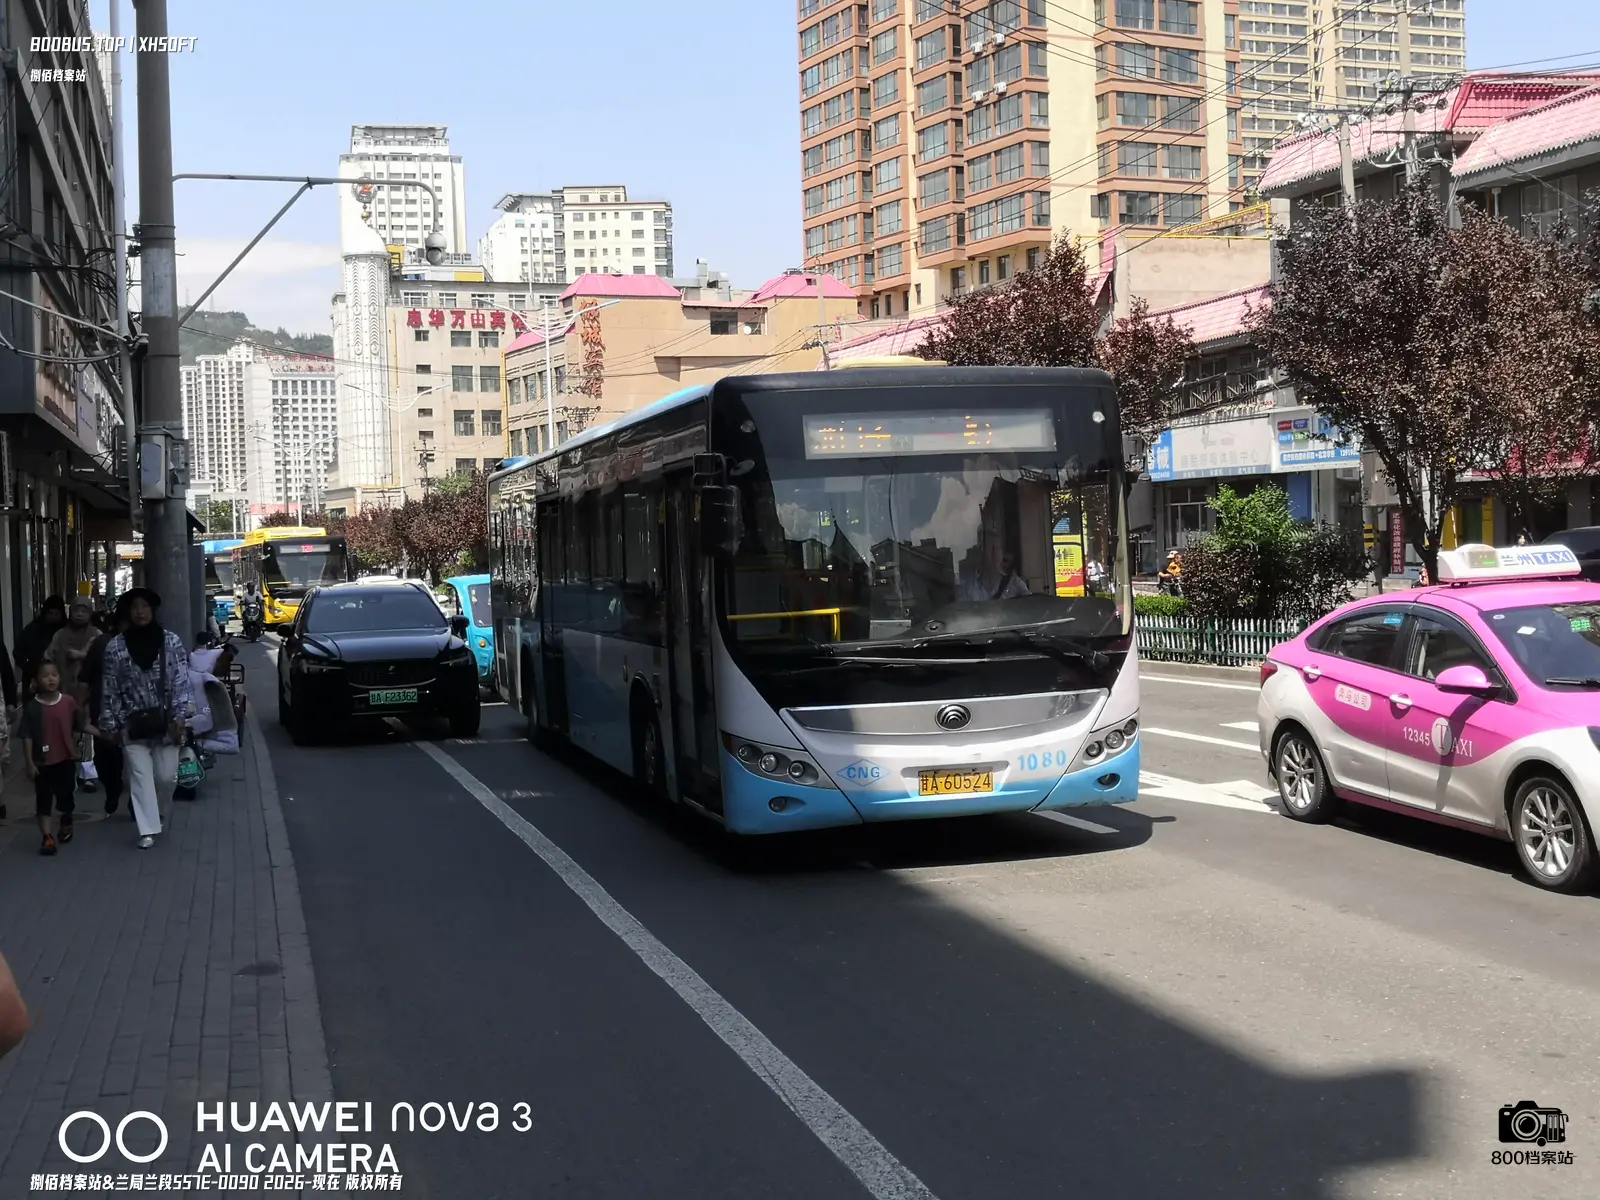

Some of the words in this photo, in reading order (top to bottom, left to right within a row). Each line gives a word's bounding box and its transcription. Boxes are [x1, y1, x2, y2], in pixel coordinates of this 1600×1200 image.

[1501, 552, 1534, 567] 兰州
[1534, 550, 1575, 564] TAXI
[1402, 726, 1431, 747] 12345
[1017, 750, 1067, 771] 1080
[846, 765, 881, 780] CNG
